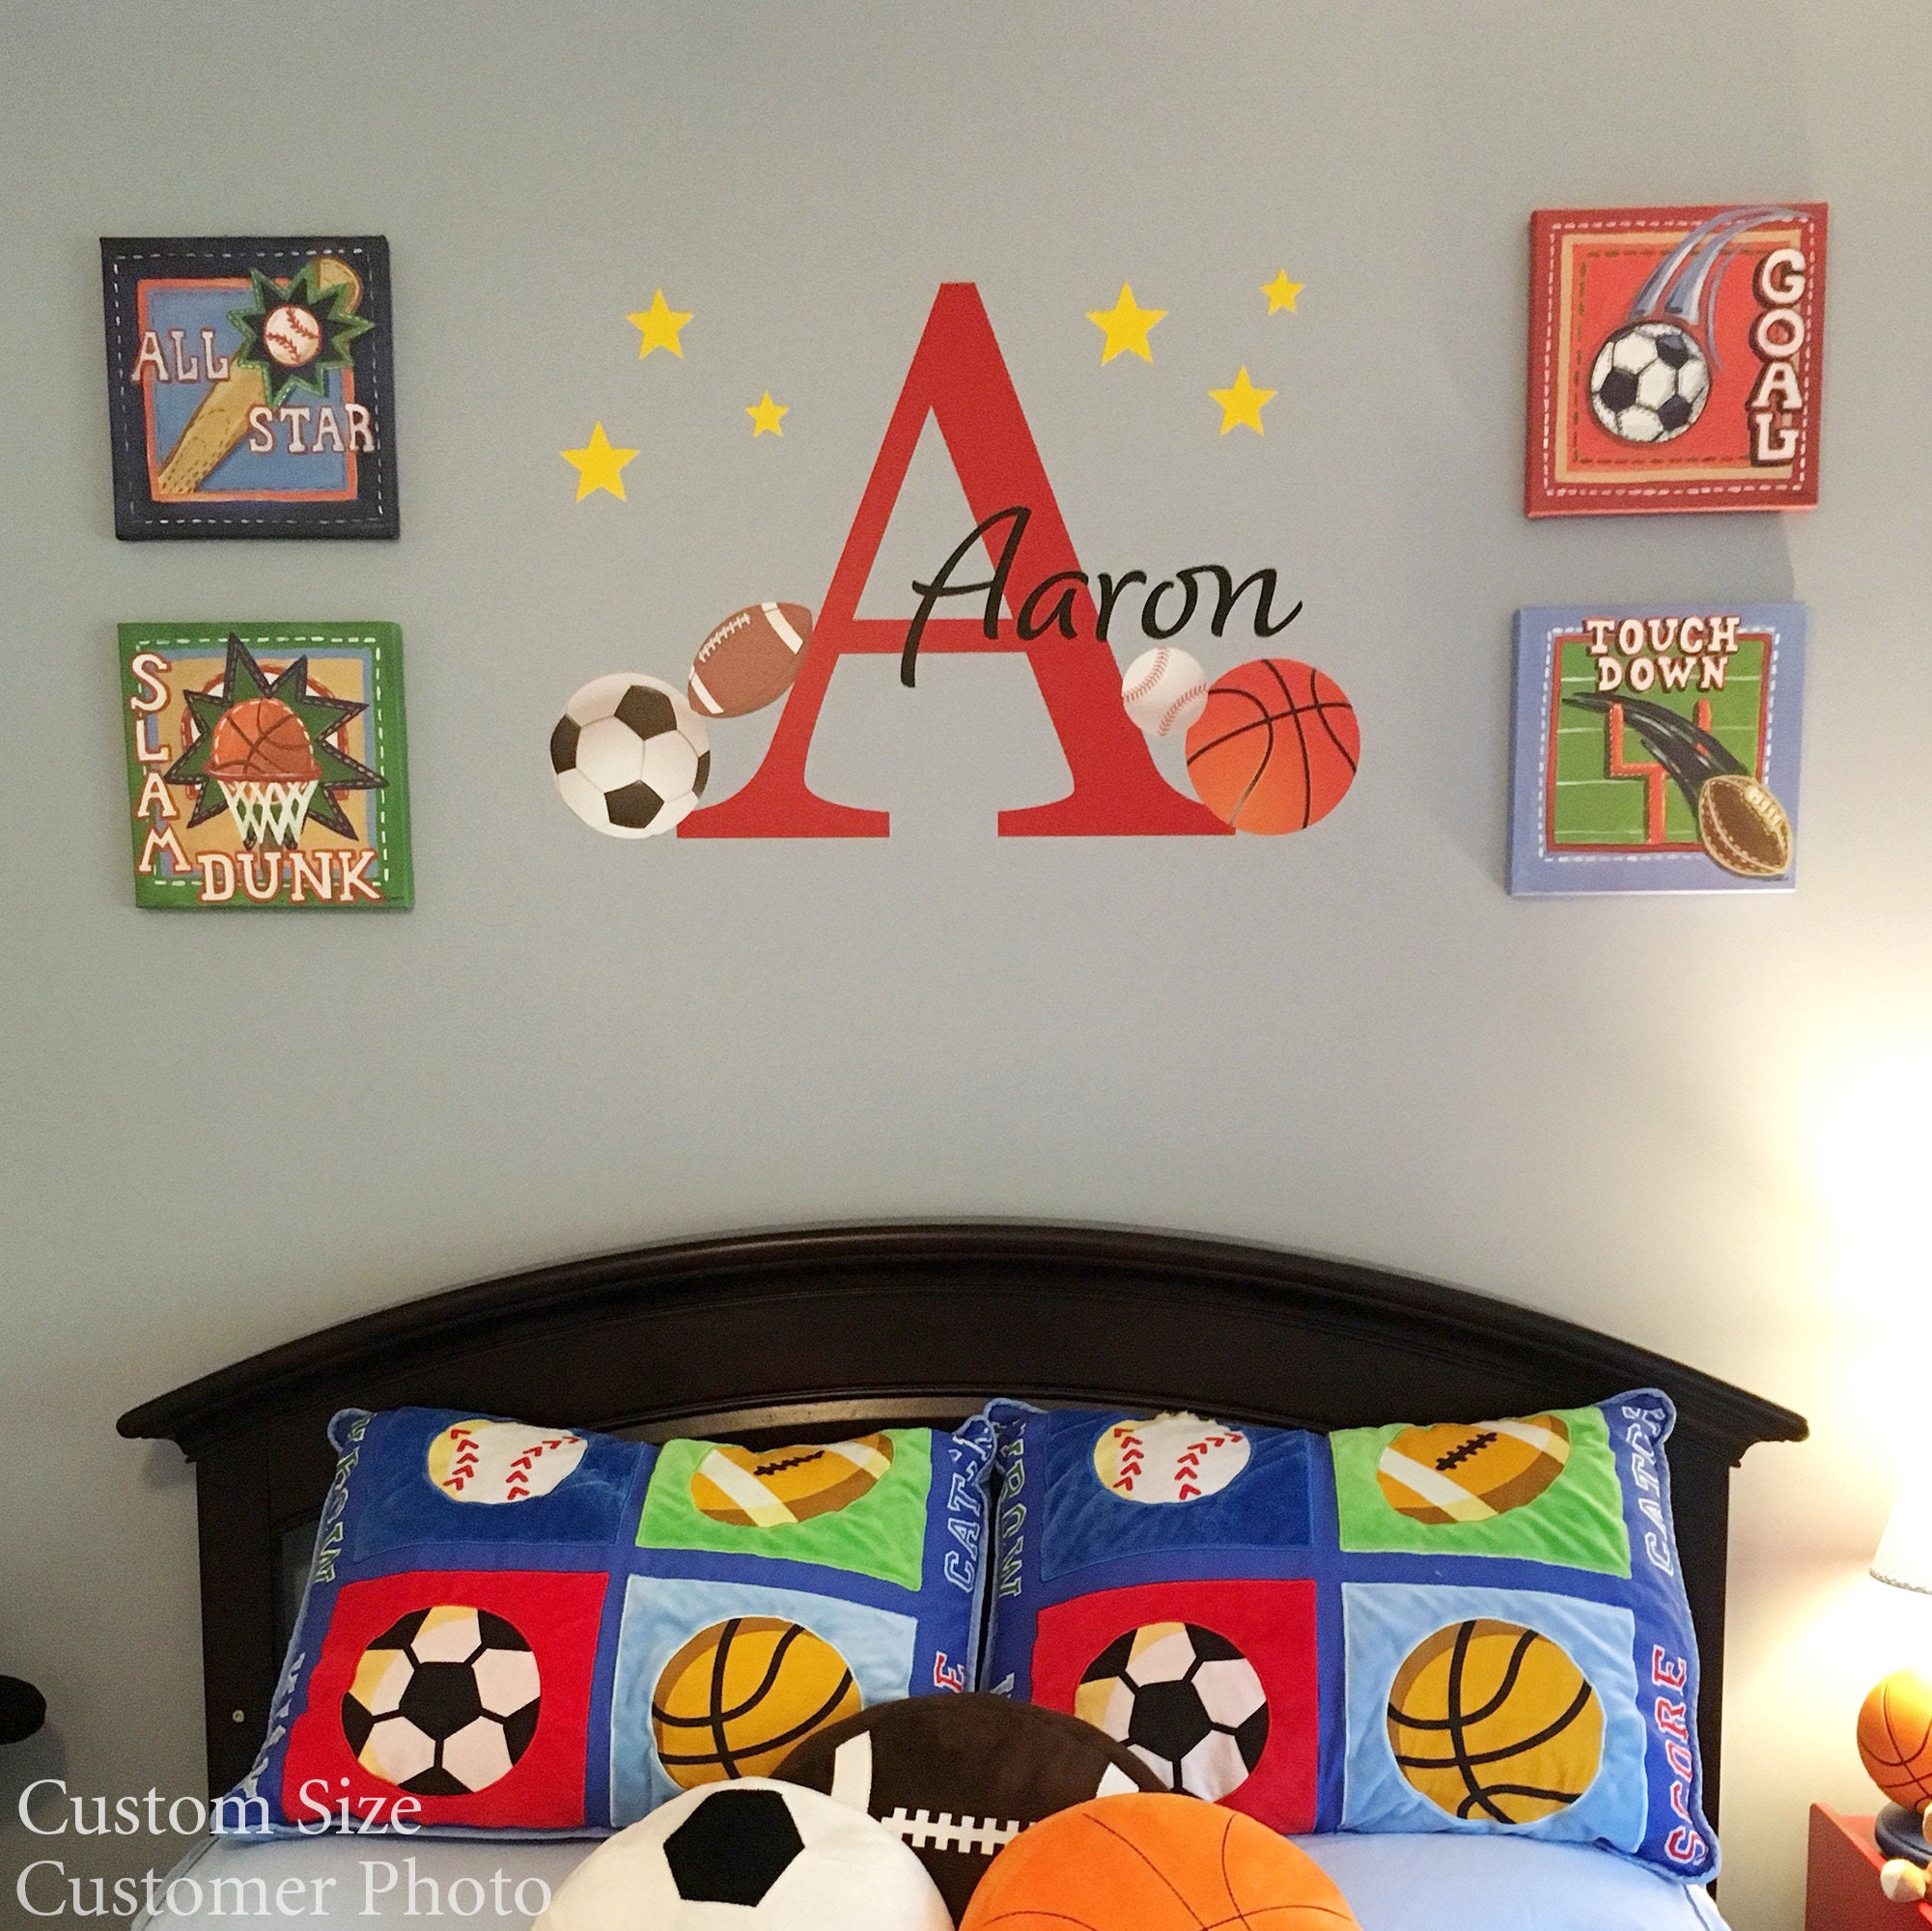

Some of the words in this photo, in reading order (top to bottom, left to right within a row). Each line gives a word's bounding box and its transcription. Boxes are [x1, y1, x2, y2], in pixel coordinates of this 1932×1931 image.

[130, 328, 230, 382] ALL
[1750, 247, 1806, 465] GOAL
[248, 404, 376, 454] STAR
[677, 282, 1236, 838] A
[900, 506, 1303, 687] Aaron
[1584, 616, 1740, 656] TOUCH
[1597, 656, 1728, 692] DOWN
[129, 652, 193, 873] SLAM
[197, 850, 383, 903] DUNK
